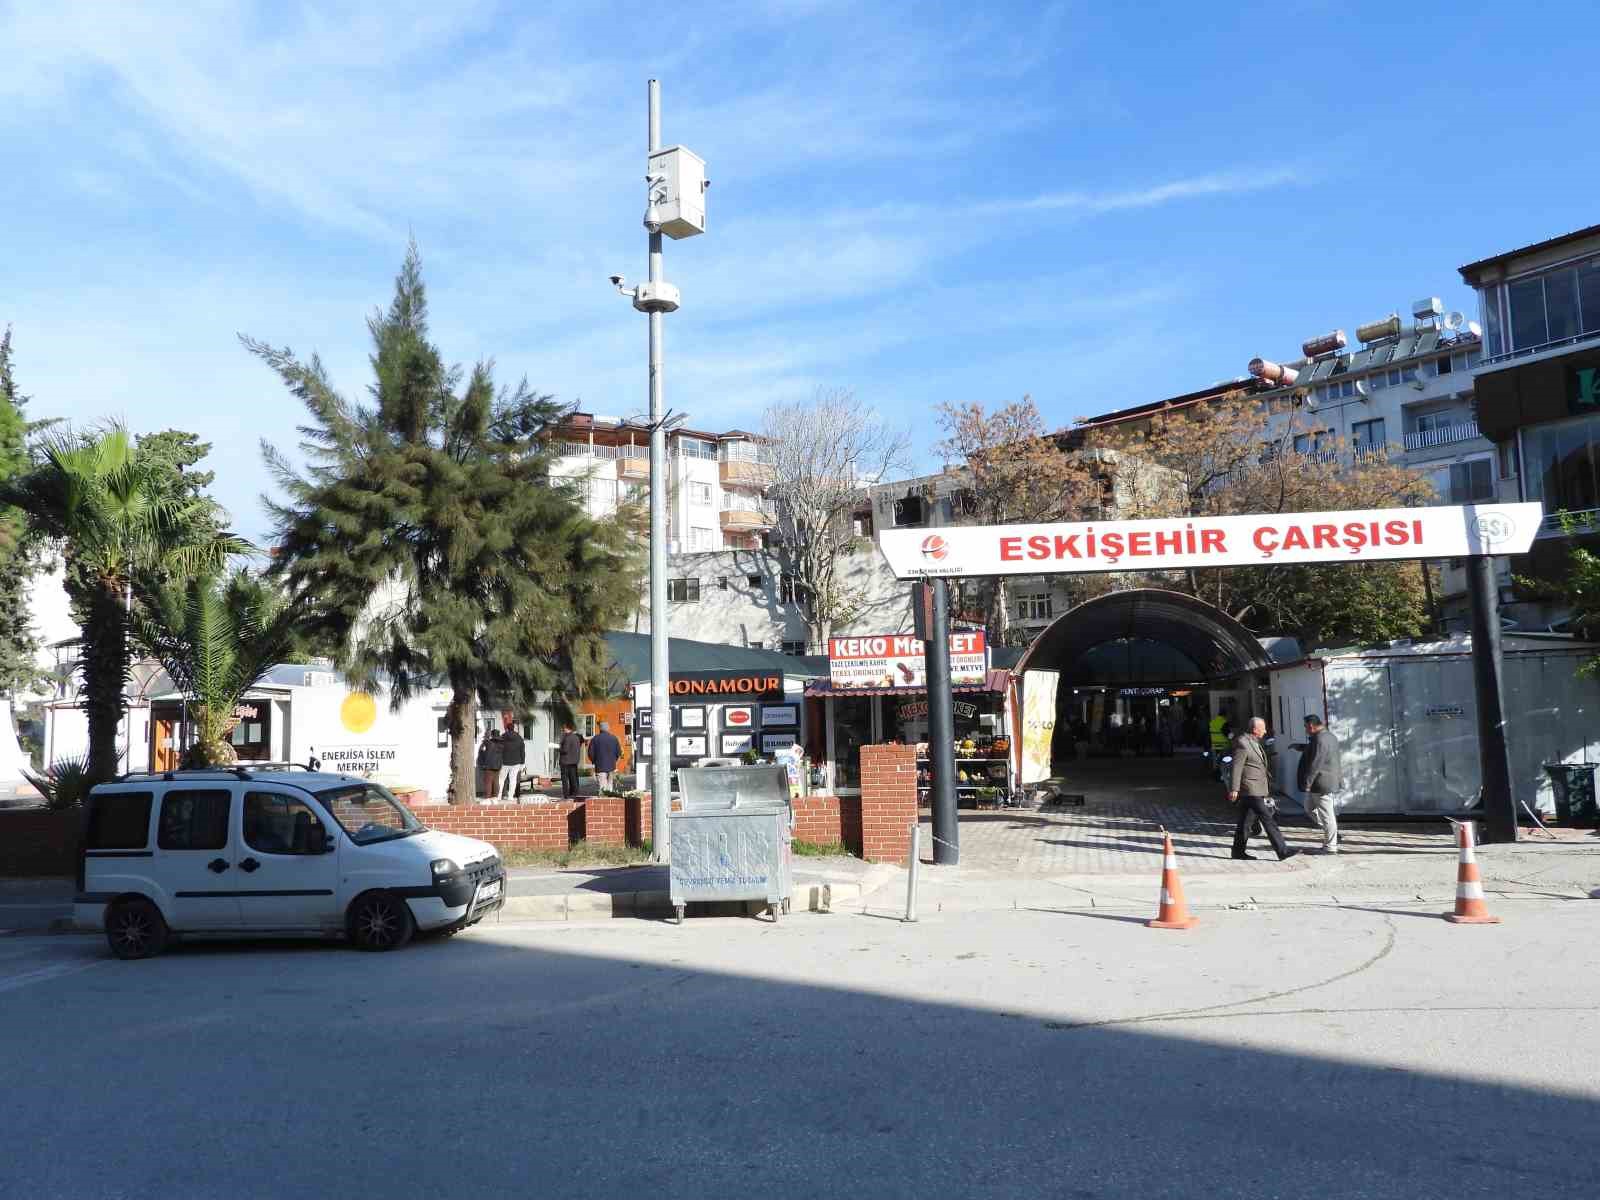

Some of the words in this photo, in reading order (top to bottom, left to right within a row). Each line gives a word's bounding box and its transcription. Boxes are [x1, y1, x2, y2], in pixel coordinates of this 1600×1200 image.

[1000, 523, 1228, 564] ESKİŞEHİR
[1253, 520, 1424, 558] ÇARŞISI
[834, 638, 887, 657] KEKO
[894, 634, 976, 655] MAET
